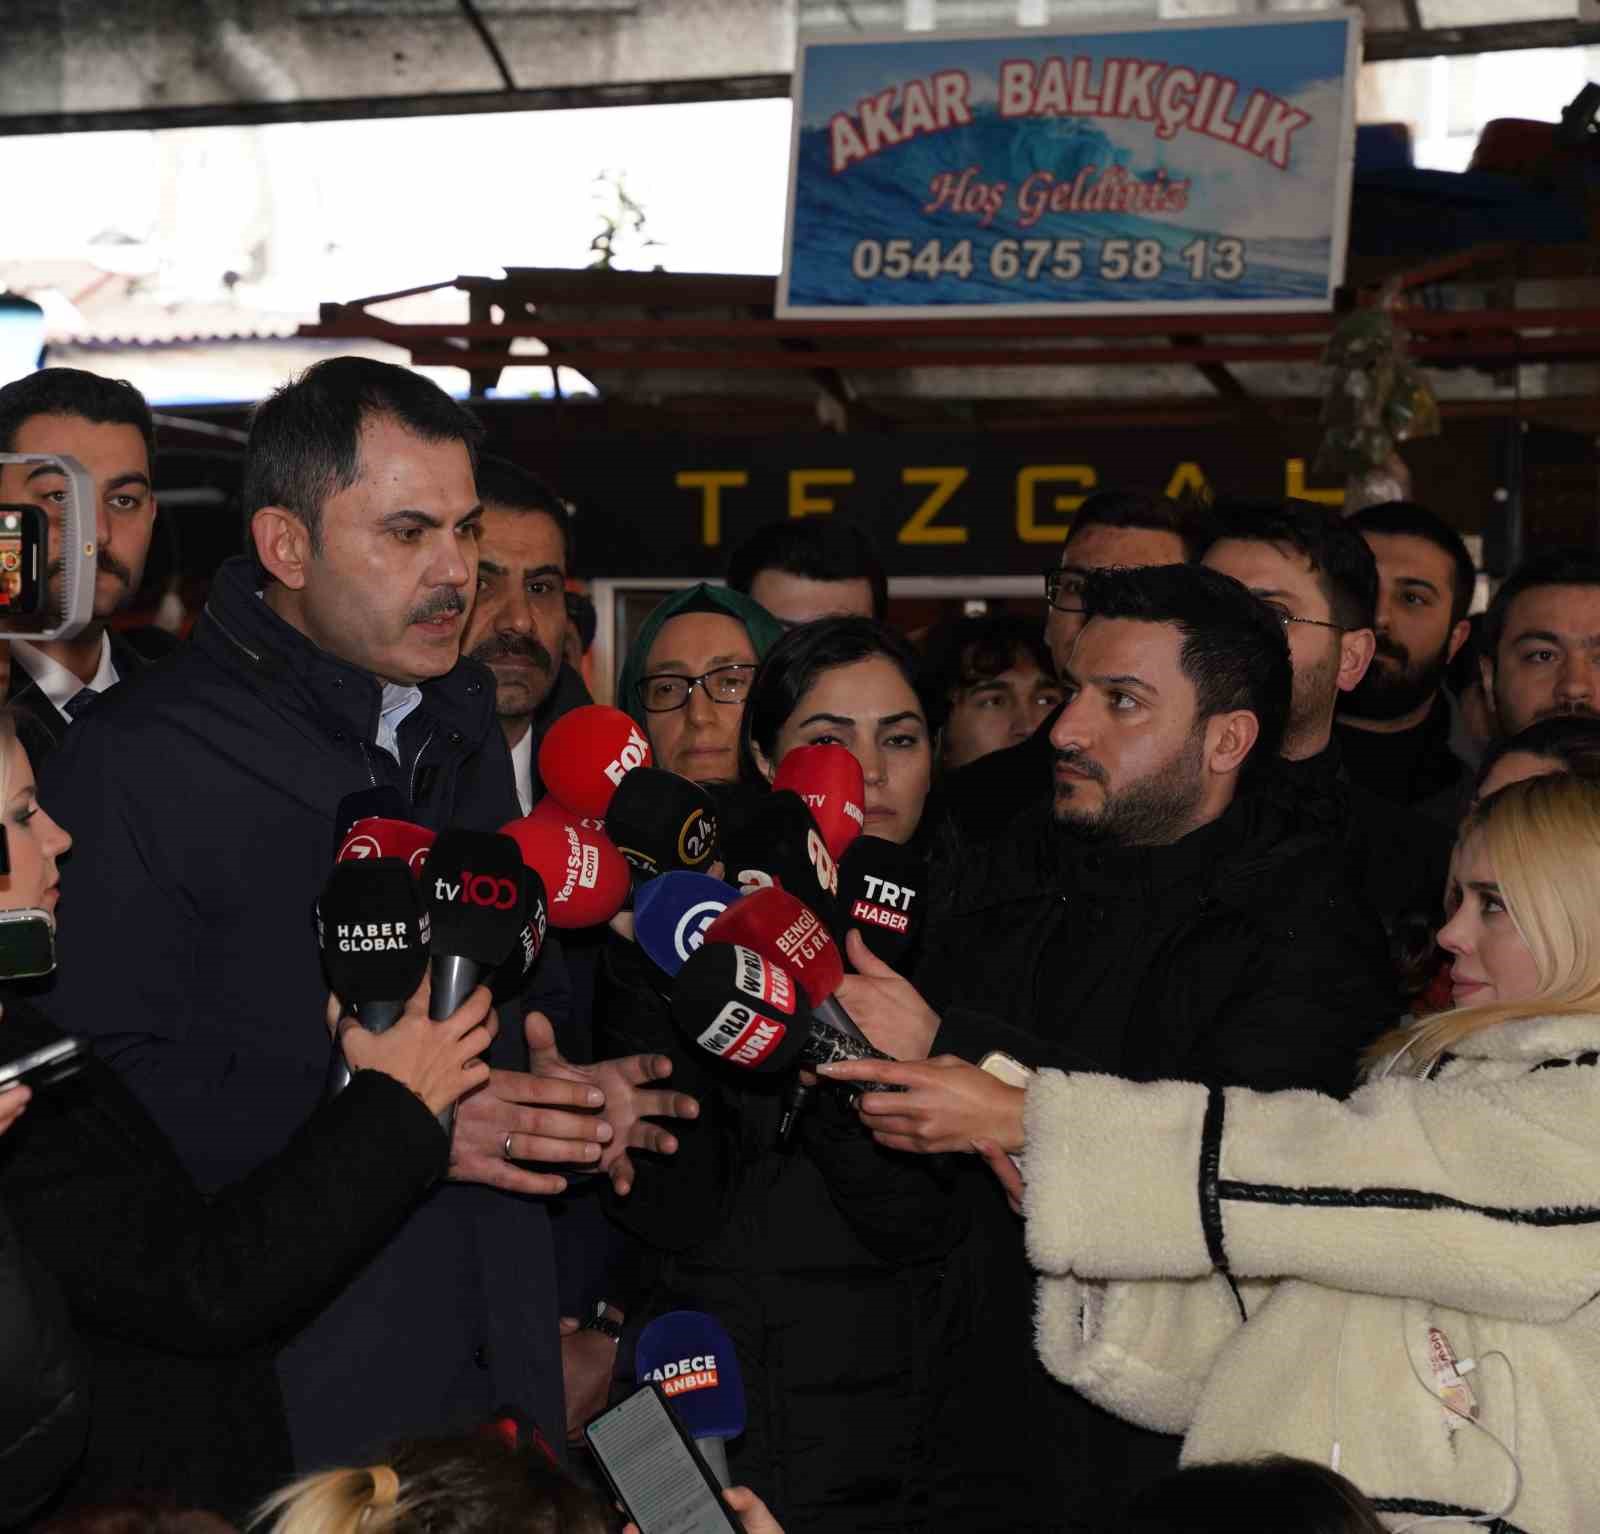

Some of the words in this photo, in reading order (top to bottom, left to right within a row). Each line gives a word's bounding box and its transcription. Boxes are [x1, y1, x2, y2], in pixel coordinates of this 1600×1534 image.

[830, 70, 973, 174] AKAR
[1001, 57, 1312, 171] BALIKÇILIK
[922, 165, 1006, 228] Hoş
[852, 239, 973, 280] 0544
[989, 239, 1082, 280] 675
[1101, 240, 1162, 280] 58
[1182, 238, 1245, 280] 13
[604, 727, 649, 786] FOX
[864, 874, 916, 911] TRT
[337, 921, 407, 938] HABER
[853, 902, 909, 931] HABER
[339, 936, 409, 952] GLOBAL
